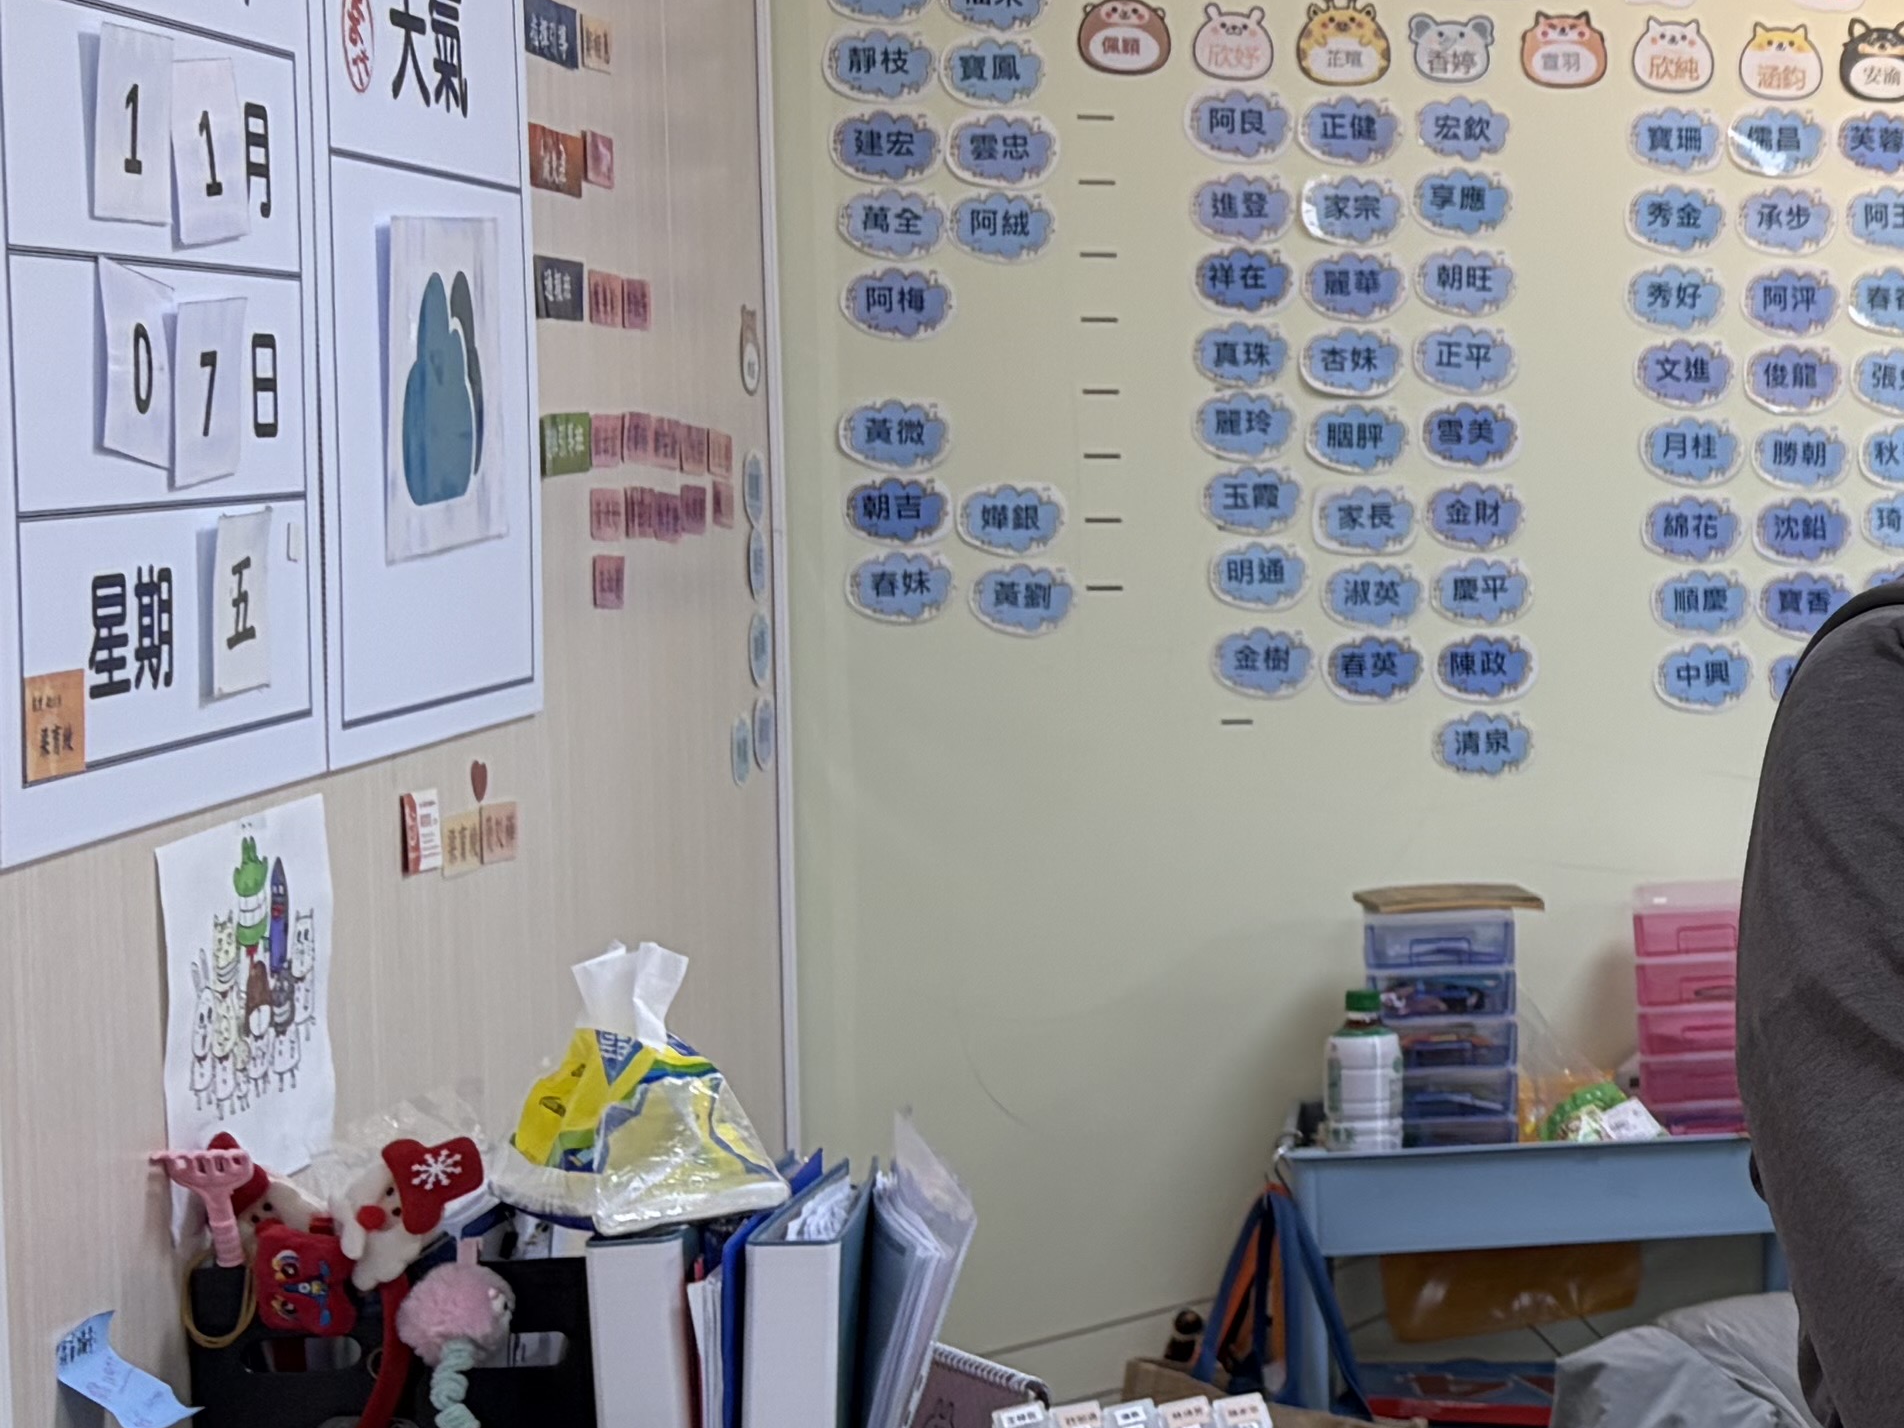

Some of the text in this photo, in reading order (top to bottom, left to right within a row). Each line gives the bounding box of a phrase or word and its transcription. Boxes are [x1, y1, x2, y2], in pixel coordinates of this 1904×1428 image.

[848, 48, 909, 75] 靜枝
[959, 54, 1021, 82] 寶鳳
[1210, 107, 1266, 137] 阿良
[1321, 113, 1377, 142] 正健
[1434, 113, 1491, 143] 宏欽
[854, 129, 914, 157] 建宏
[970, 133, 1030, 161] 雲忠
[1646, 125, 1702, 154] 寶珊
[1746, 124, 1801, 154] 儒昌
[1849, 125, 1904, 154] 芙蓉
[1211, 190, 1269, 221] 進登
[1323, 192, 1381, 222] 家宗
[1646, 202, 1702, 229] 秀金
[1757, 203, 1812, 230] 承步
[862, 206, 922, 235] 萬全
[970, 209, 1030, 237] 阿絨
[1209, 260, 1266, 292] 祥在
[1323, 268, 1381, 298] 麗華
[1437, 263, 1493, 294] 朝旺
[865, 286, 925, 314] 阿梅
[1646, 282, 1701, 310] 秀好
[1435, 341, 1491, 369] 正平
[1655, 356, 1711, 384] 文進
[1764, 361, 1818, 390] 俊龍
[1215, 408, 1272, 436] 麗玲
[1437, 418, 1494, 446] 雪美
[1663, 432, 1717, 459] 月桂
[1773, 440, 1827, 469] 勝朝
[862, 494, 922, 521] 朝吉
[1222, 483, 1280, 511] 玉霞
[1338, 503, 1395, 531] 家長
[1445, 498, 1501, 526] 金財
[1663, 512, 1718, 540] 綿花
[871, 570, 931, 598] 春妹
[1227, 556, 1286, 585] 明通
[1344, 578, 1401, 606] 淑英
[1453, 575, 1509, 603] 慶平
[1673, 586, 1728, 613] 順慶
[1778, 586, 1832, 613] 寶香
[88, 555, 259, 701] 星期五
[1233, 644, 1291, 672] 金樹
[1341, 650, 1398, 678] 春英
[1450, 650, 1508, 678] 陳政
[1676, 659, 1731, 687] 中興
[1454, 729, 1512, 757] 清泉
